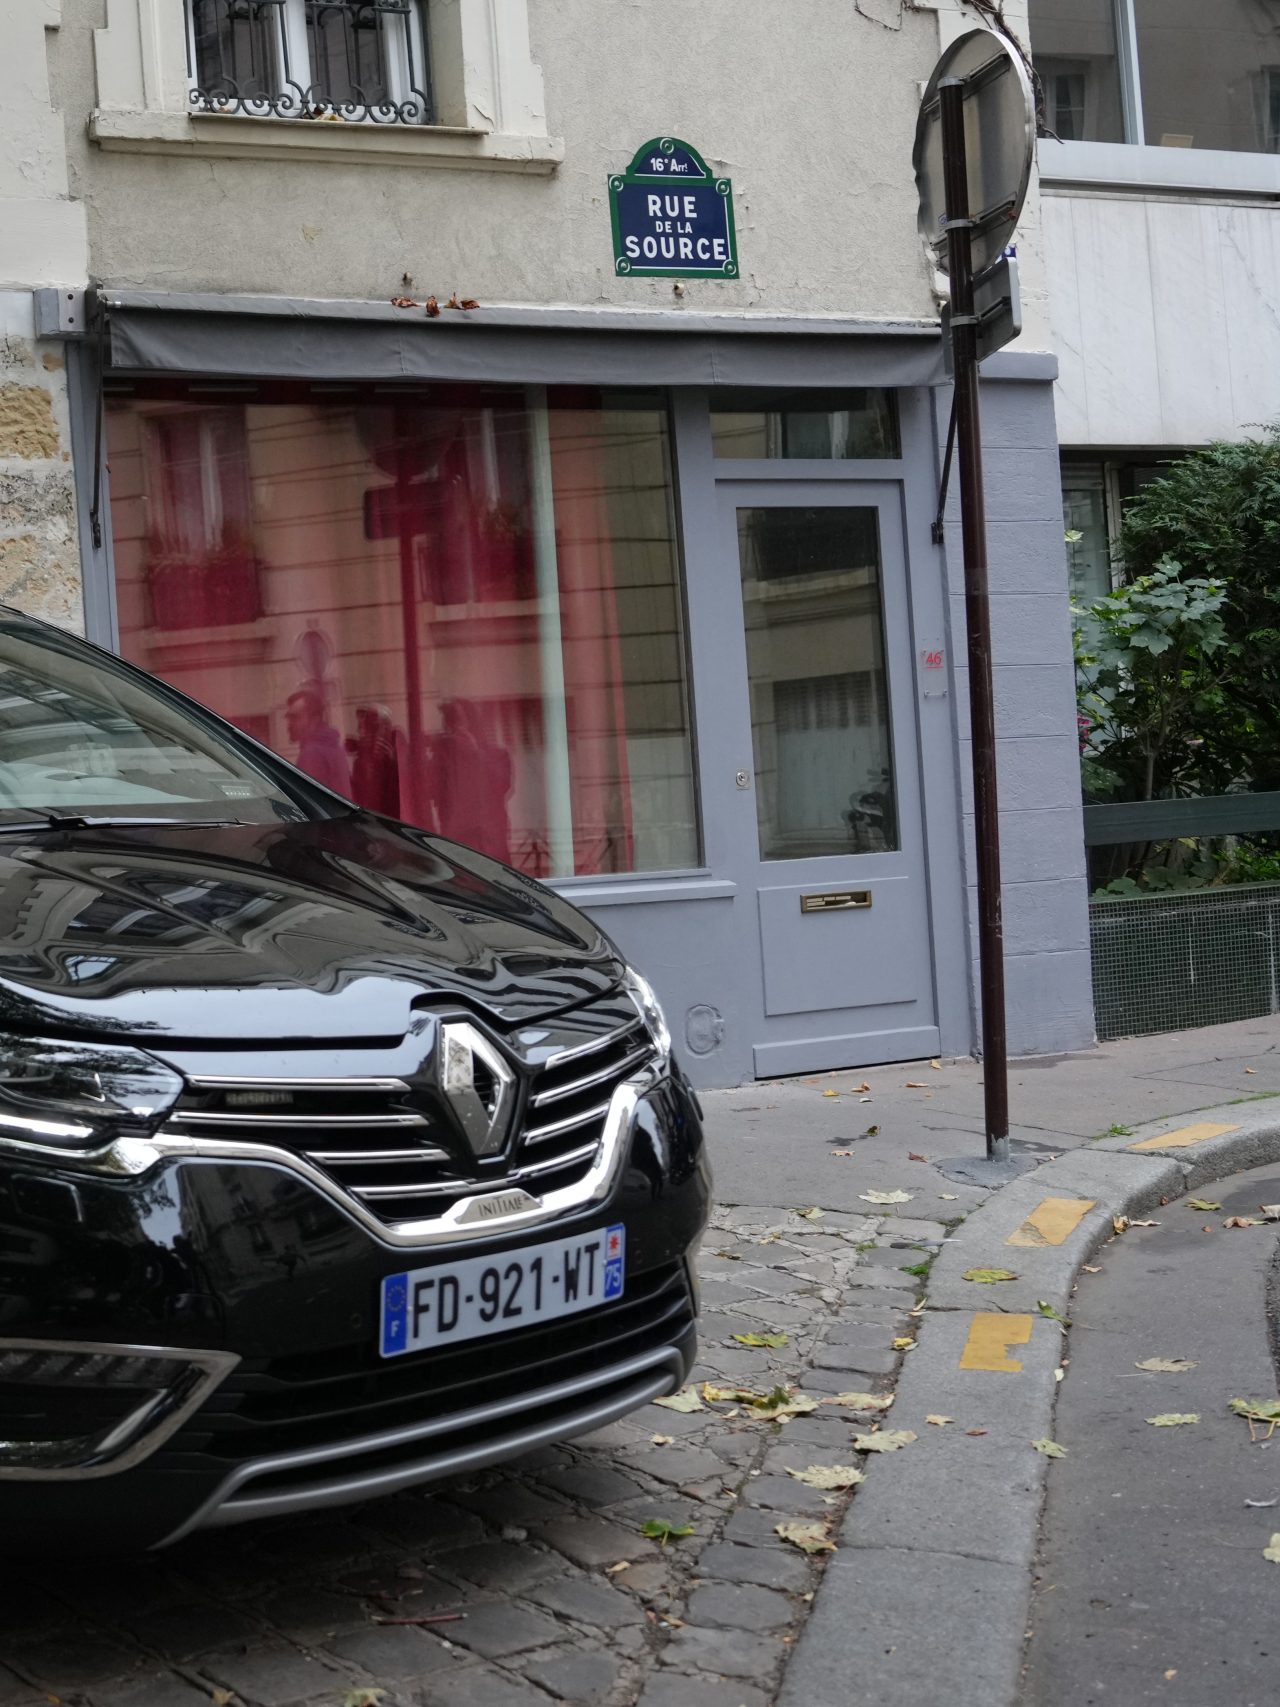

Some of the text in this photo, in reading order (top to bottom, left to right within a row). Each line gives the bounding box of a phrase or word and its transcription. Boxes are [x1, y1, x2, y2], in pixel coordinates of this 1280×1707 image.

[647, 194, 698, 218] RUE
[655, 220, 693, 234] DE LA
[625, 235, 727, 261] SOURCE
[390, 1241, 621, 1339] F FD-921-WT 75
